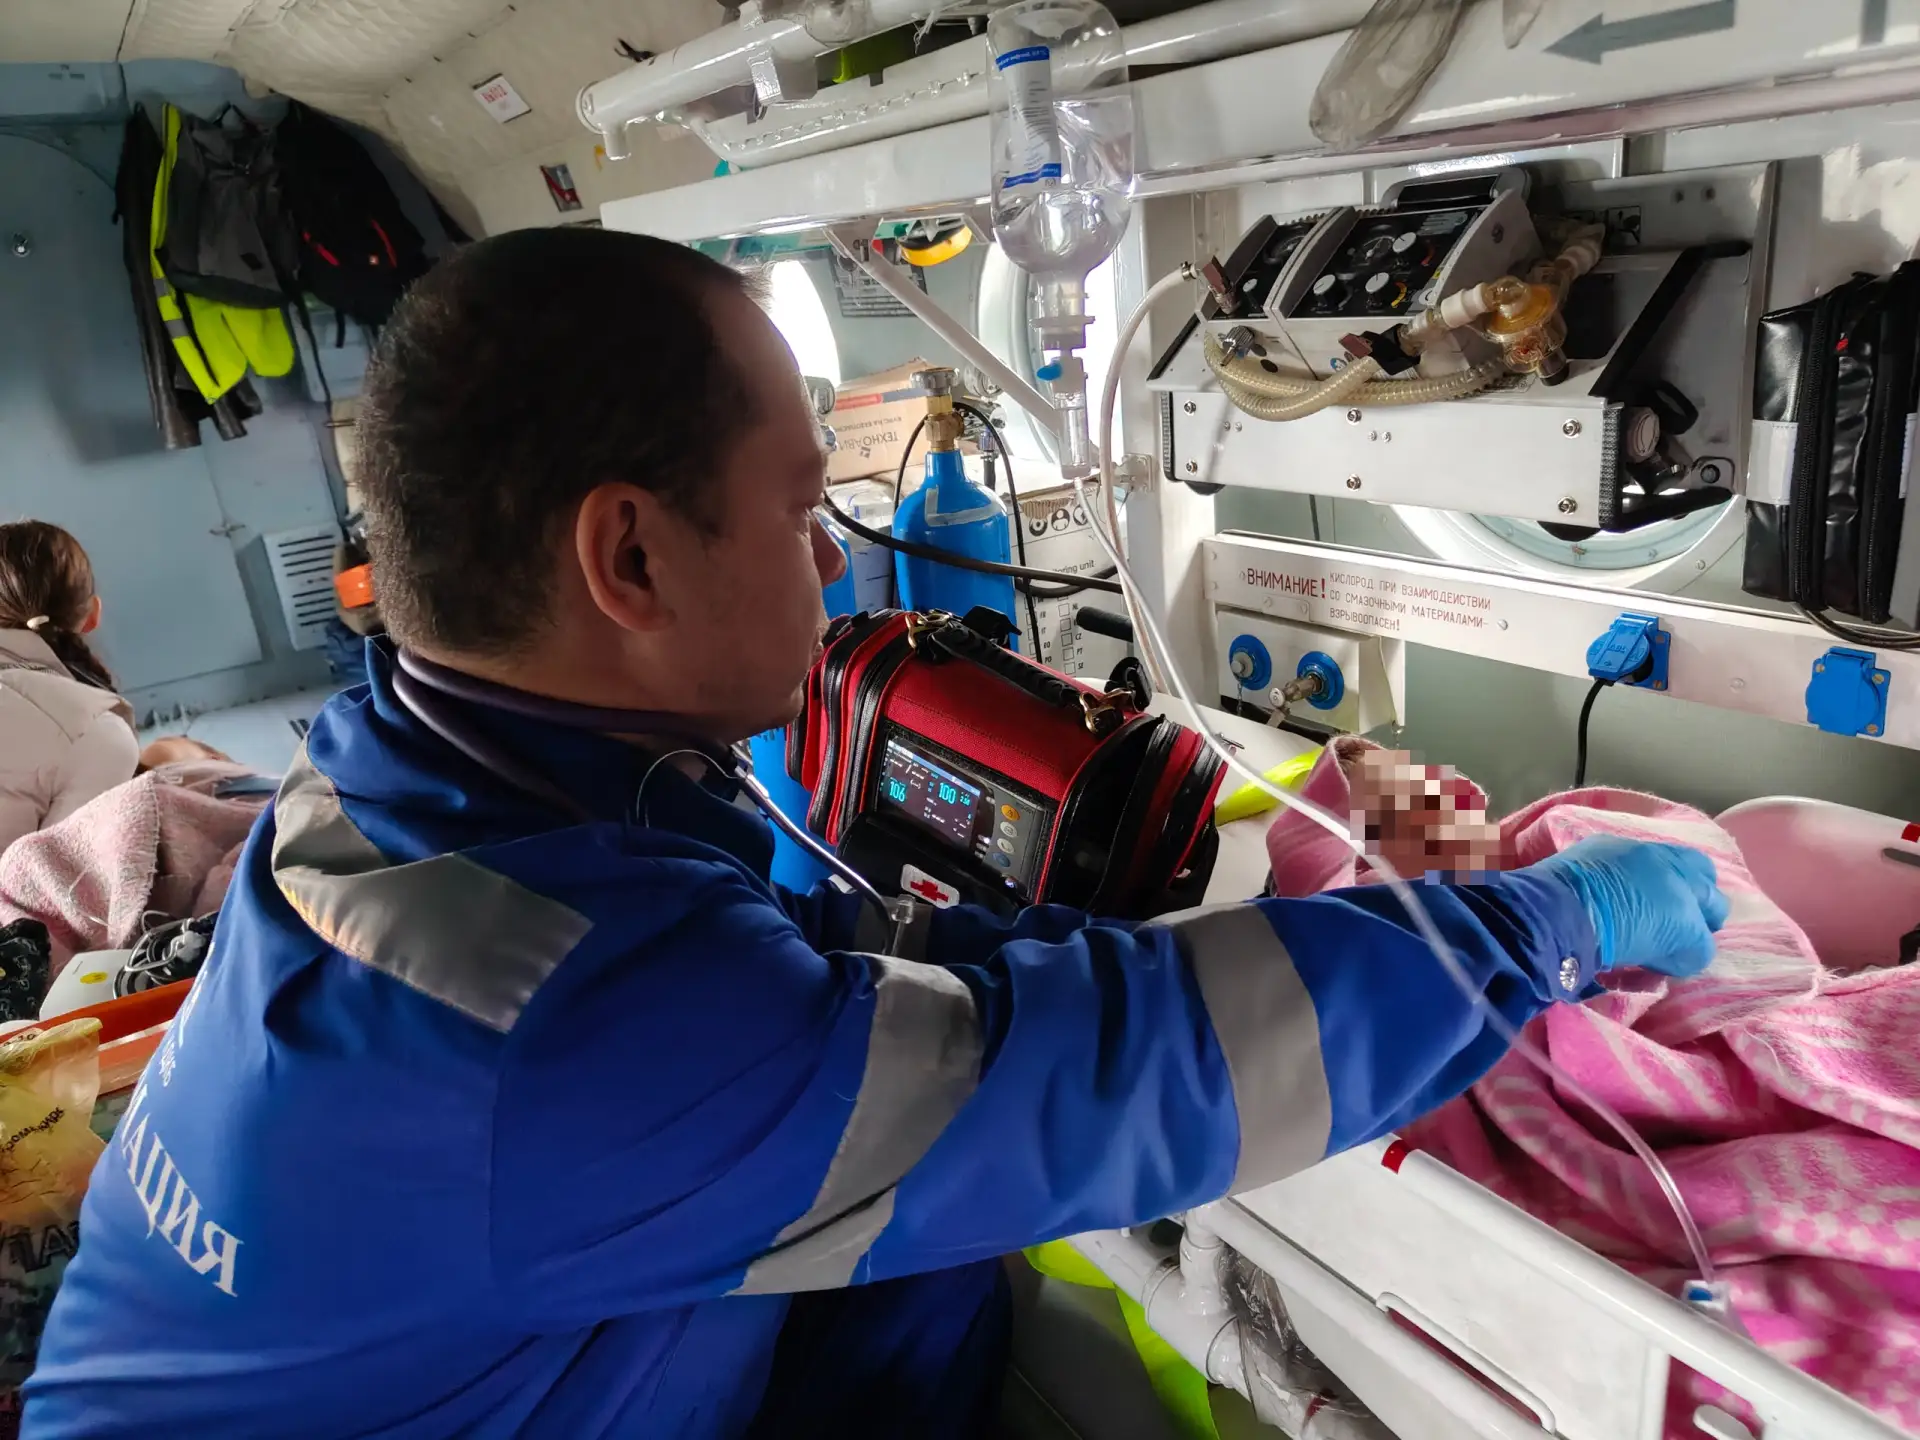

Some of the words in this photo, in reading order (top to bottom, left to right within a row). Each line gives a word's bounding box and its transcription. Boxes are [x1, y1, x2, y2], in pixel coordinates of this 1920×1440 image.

[839, 431, 898, 450] ТЕХНОАВИ
[1079, 560, 1094, 570] unit
[1247, 568, 1326, 599] ВНИМАНИЕ!
[1329, 571, 1374, 590] КИСЛОРОД
[1379, 580, 1397, 595] ПРИ
[1329, 590, 1344, 600] СО
[1345, 592, 1407, 614] СМАЗОЧНЫМИ
[1329, 607, 1401, 632] ВЗРЫВООПАСЕН!
[889, 781, 907, 802] 106
[938, 782, 957, 805] 100
[121, 1083, 245, 1298] АЦИЯ
